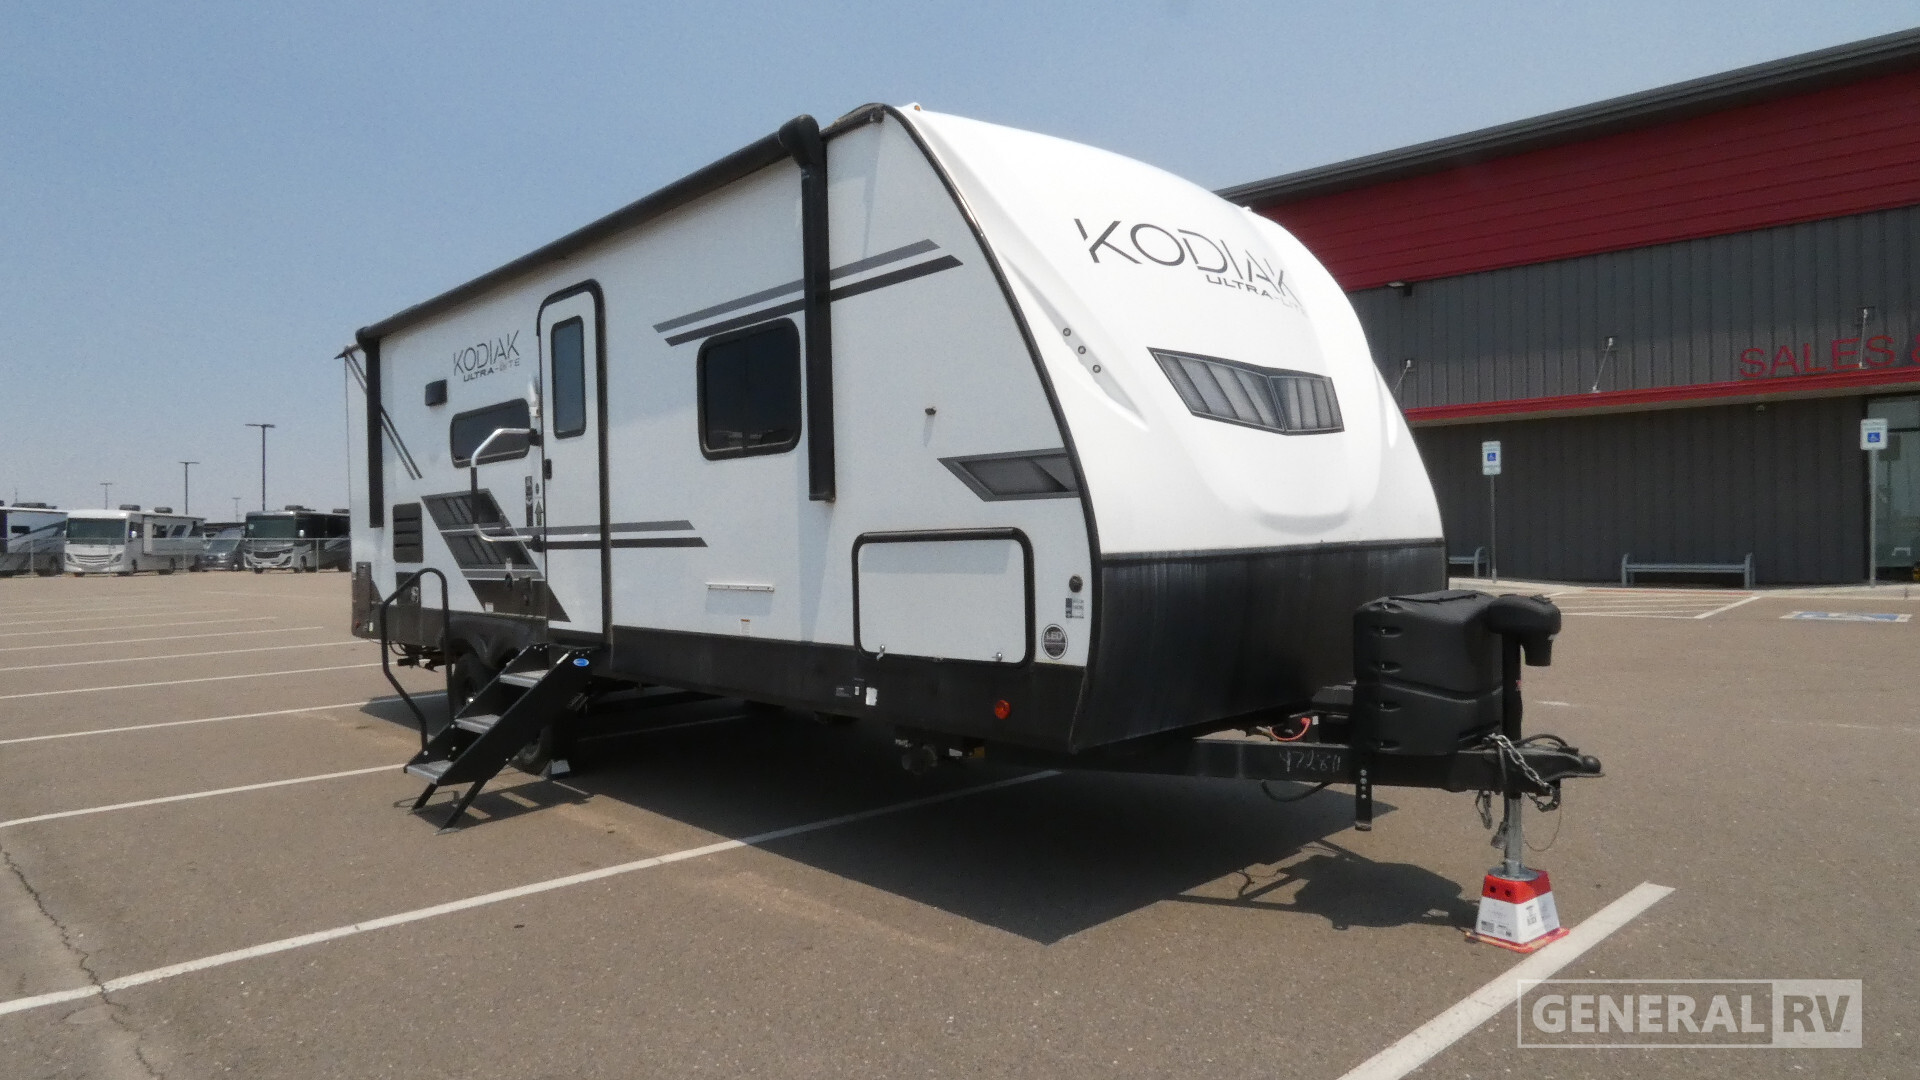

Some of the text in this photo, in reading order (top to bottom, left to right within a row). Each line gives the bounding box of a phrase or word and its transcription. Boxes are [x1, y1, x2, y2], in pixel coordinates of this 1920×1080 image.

[1074, 218, 1302, 307] KODIAK
[453, 330, 520, 376] KODIAK
[463, 357, 520, 382] ULTRA-TE
[1739, 334, 1896, 378] SALES
[1046, 631, 1063, 640] LED
